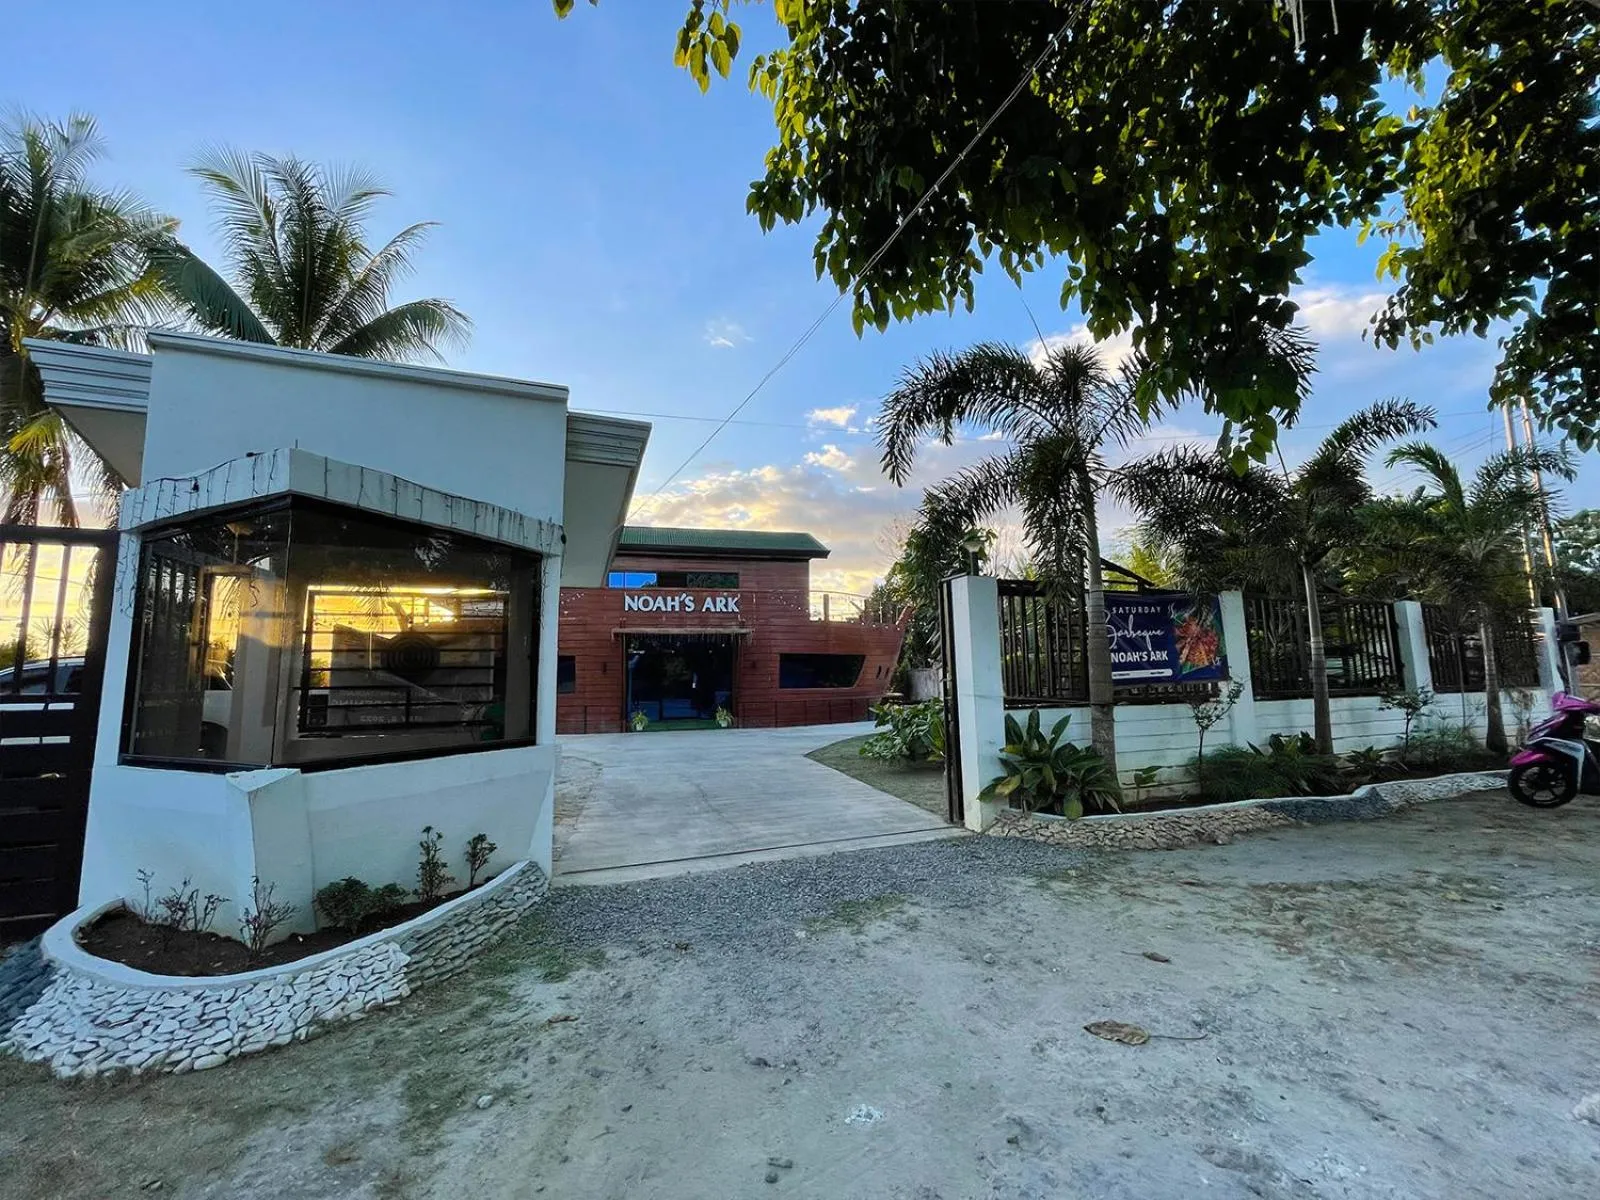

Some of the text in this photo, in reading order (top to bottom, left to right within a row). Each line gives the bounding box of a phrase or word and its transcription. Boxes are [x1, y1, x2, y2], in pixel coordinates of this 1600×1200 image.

[625, 593, 739, 612] NOAH'S ARK
[1112, 606, 1161, 614] SATURDAY
[1110, 650, 1168, 663] NOAH'S ARK
